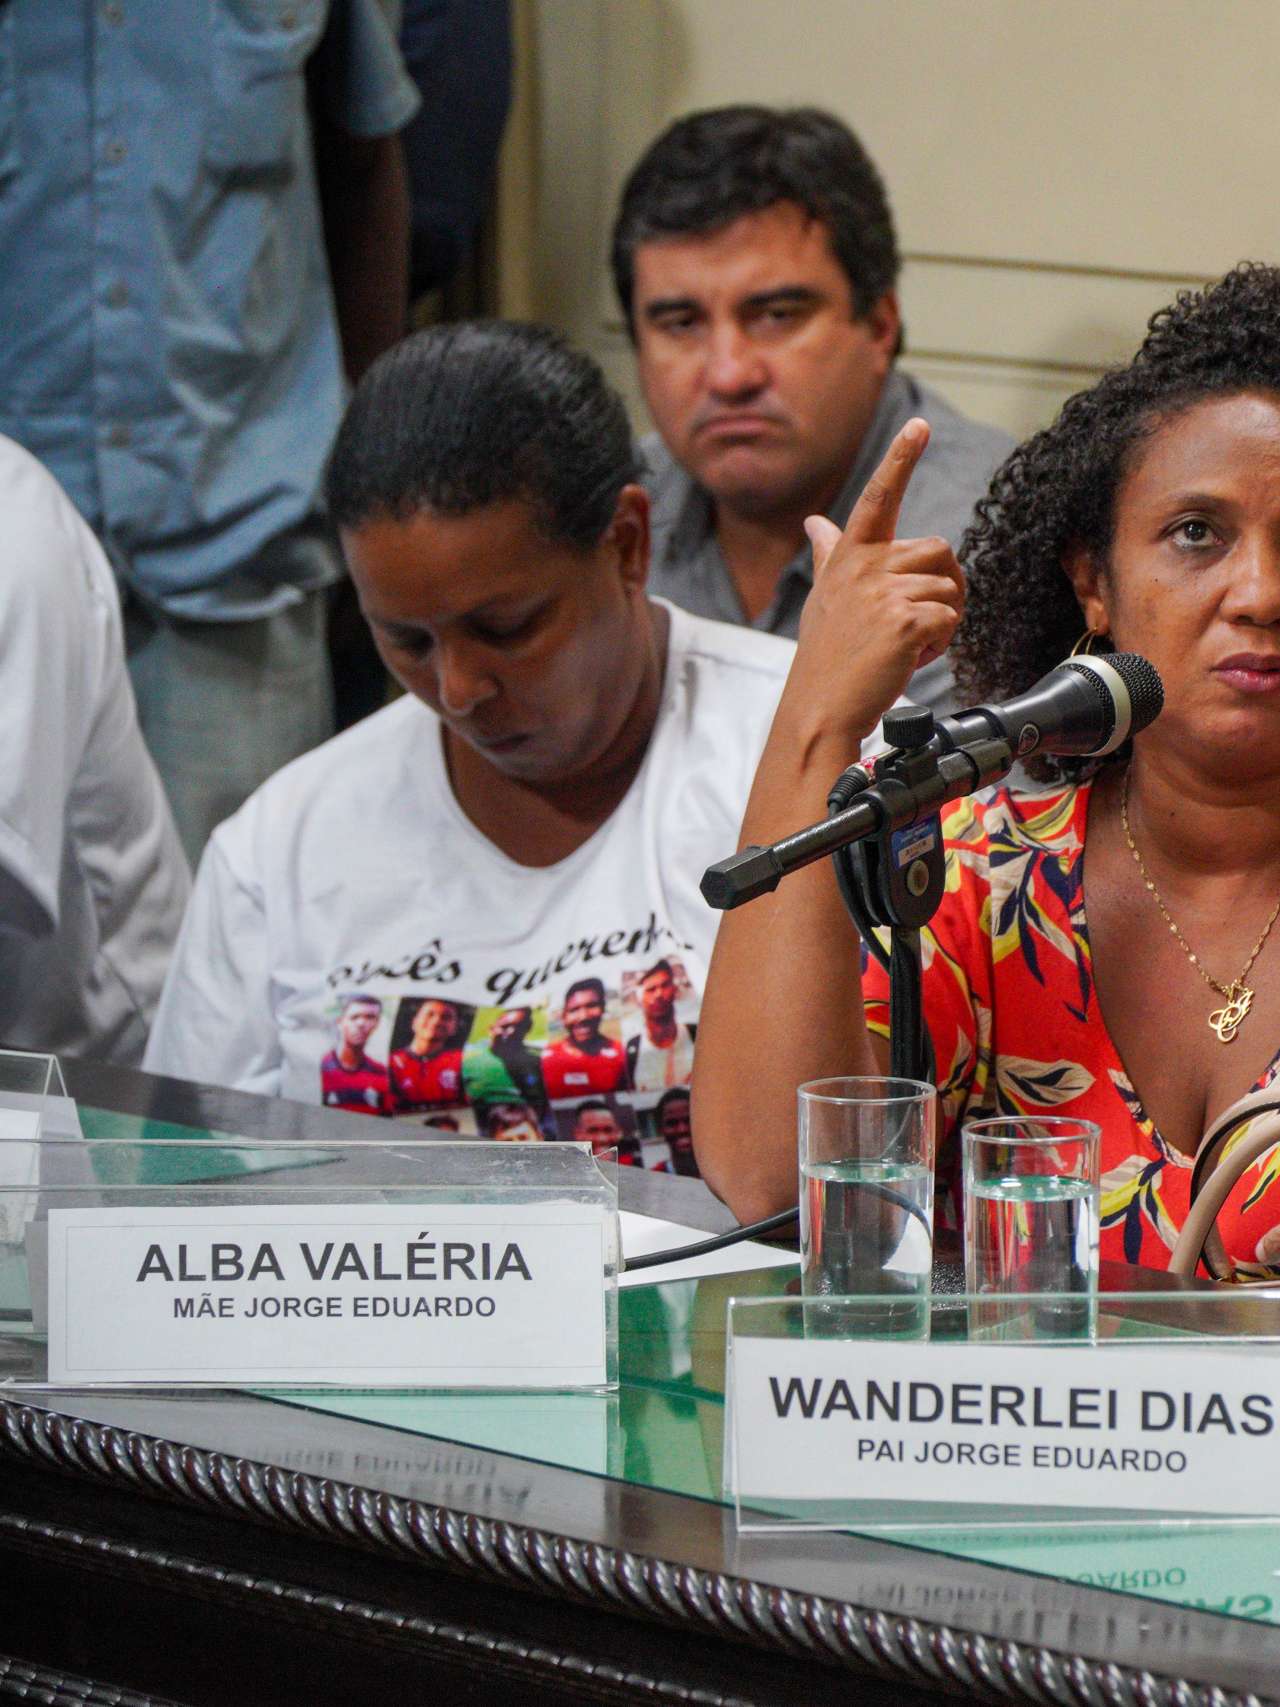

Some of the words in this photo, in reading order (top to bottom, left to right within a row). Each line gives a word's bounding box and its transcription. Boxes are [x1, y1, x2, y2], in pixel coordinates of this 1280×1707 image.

[136, 1243, 285, 1282] ALBA
[300, 1232, 532, 1281] VALÉRIA
[173, 1292, 234, 1319] MÃE
[244, 1296, 343, 1318] JORGE
[353, 1296, 496, 1318] EDUARDO
[768, 1376, 1117, 1430] WANDERLEI
[1141, 1390, 1274, 1436] DIAS
[858, 1439, 903, 1463] PAI
[914, 1441, 1021, 1466] JORGE
[1033, 1445, 1187, 1473] EDUARDO
